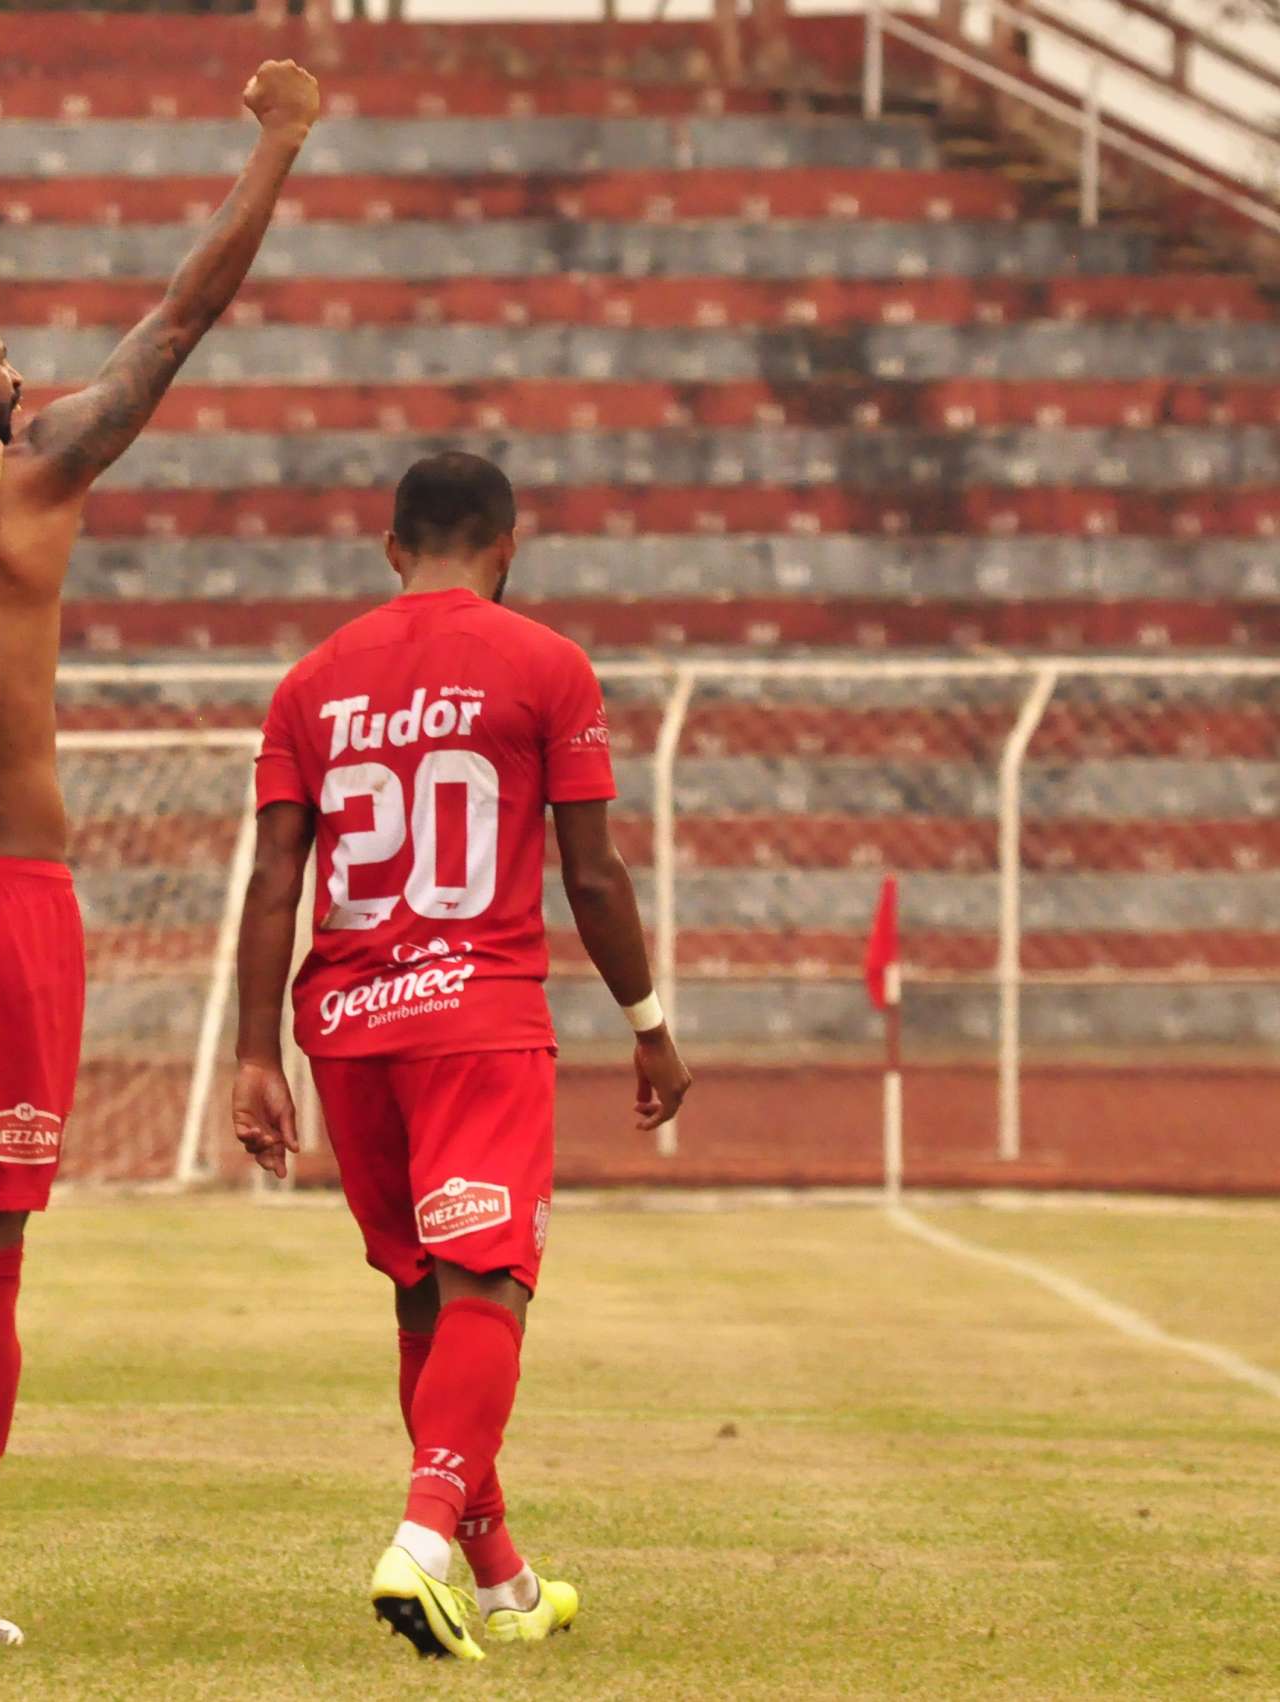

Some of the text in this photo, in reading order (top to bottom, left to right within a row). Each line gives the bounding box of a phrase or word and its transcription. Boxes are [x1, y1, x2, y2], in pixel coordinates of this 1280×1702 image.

[318, 687, 483, 761] Tudor
[320, 749, 500, 930] 20
[366, 997, 460, 1029] Distribuidora
[422, 1198, 500, 1229] MEZZANI
